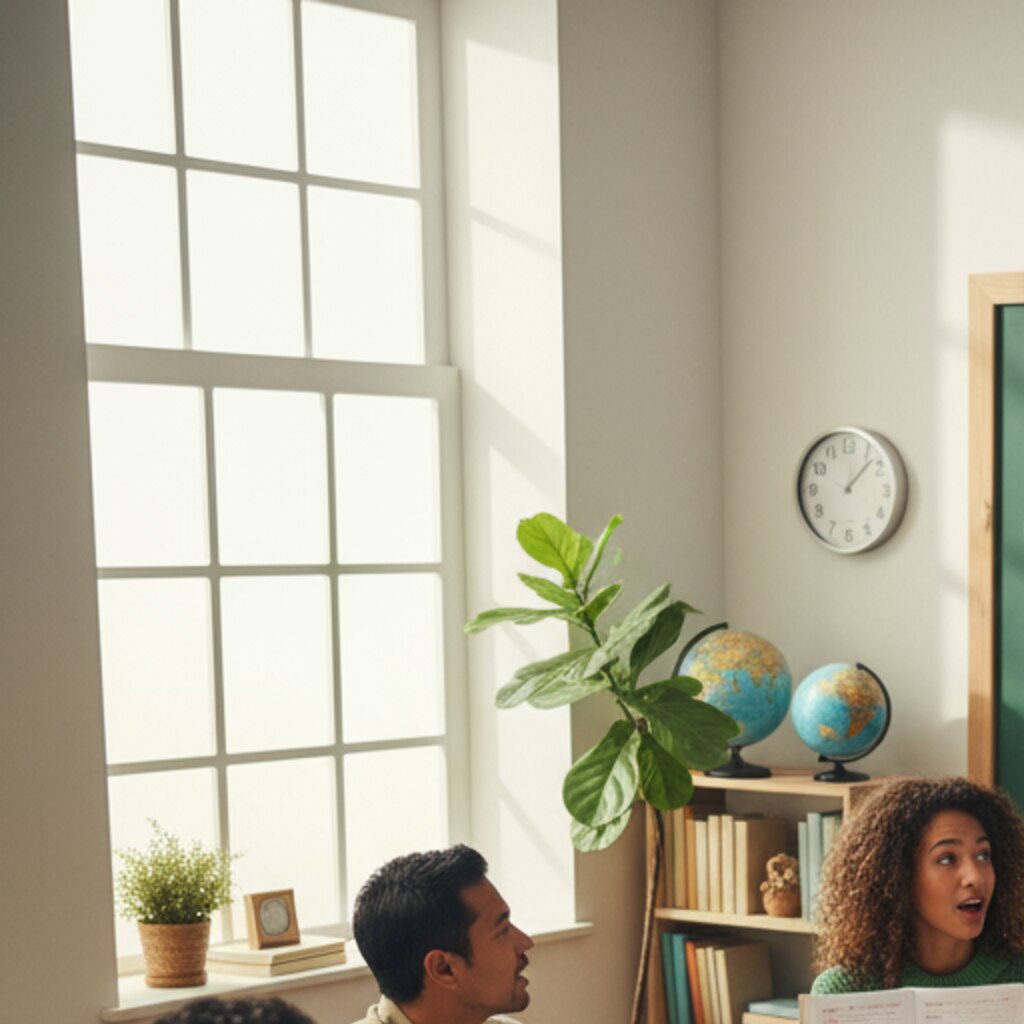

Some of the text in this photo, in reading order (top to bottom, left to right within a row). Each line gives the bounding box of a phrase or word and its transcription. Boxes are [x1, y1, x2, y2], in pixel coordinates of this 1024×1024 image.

[882, 484, 891, 498] 3
[814, 503, 823, 518] 8
[829, 520, 837, 536] 7
